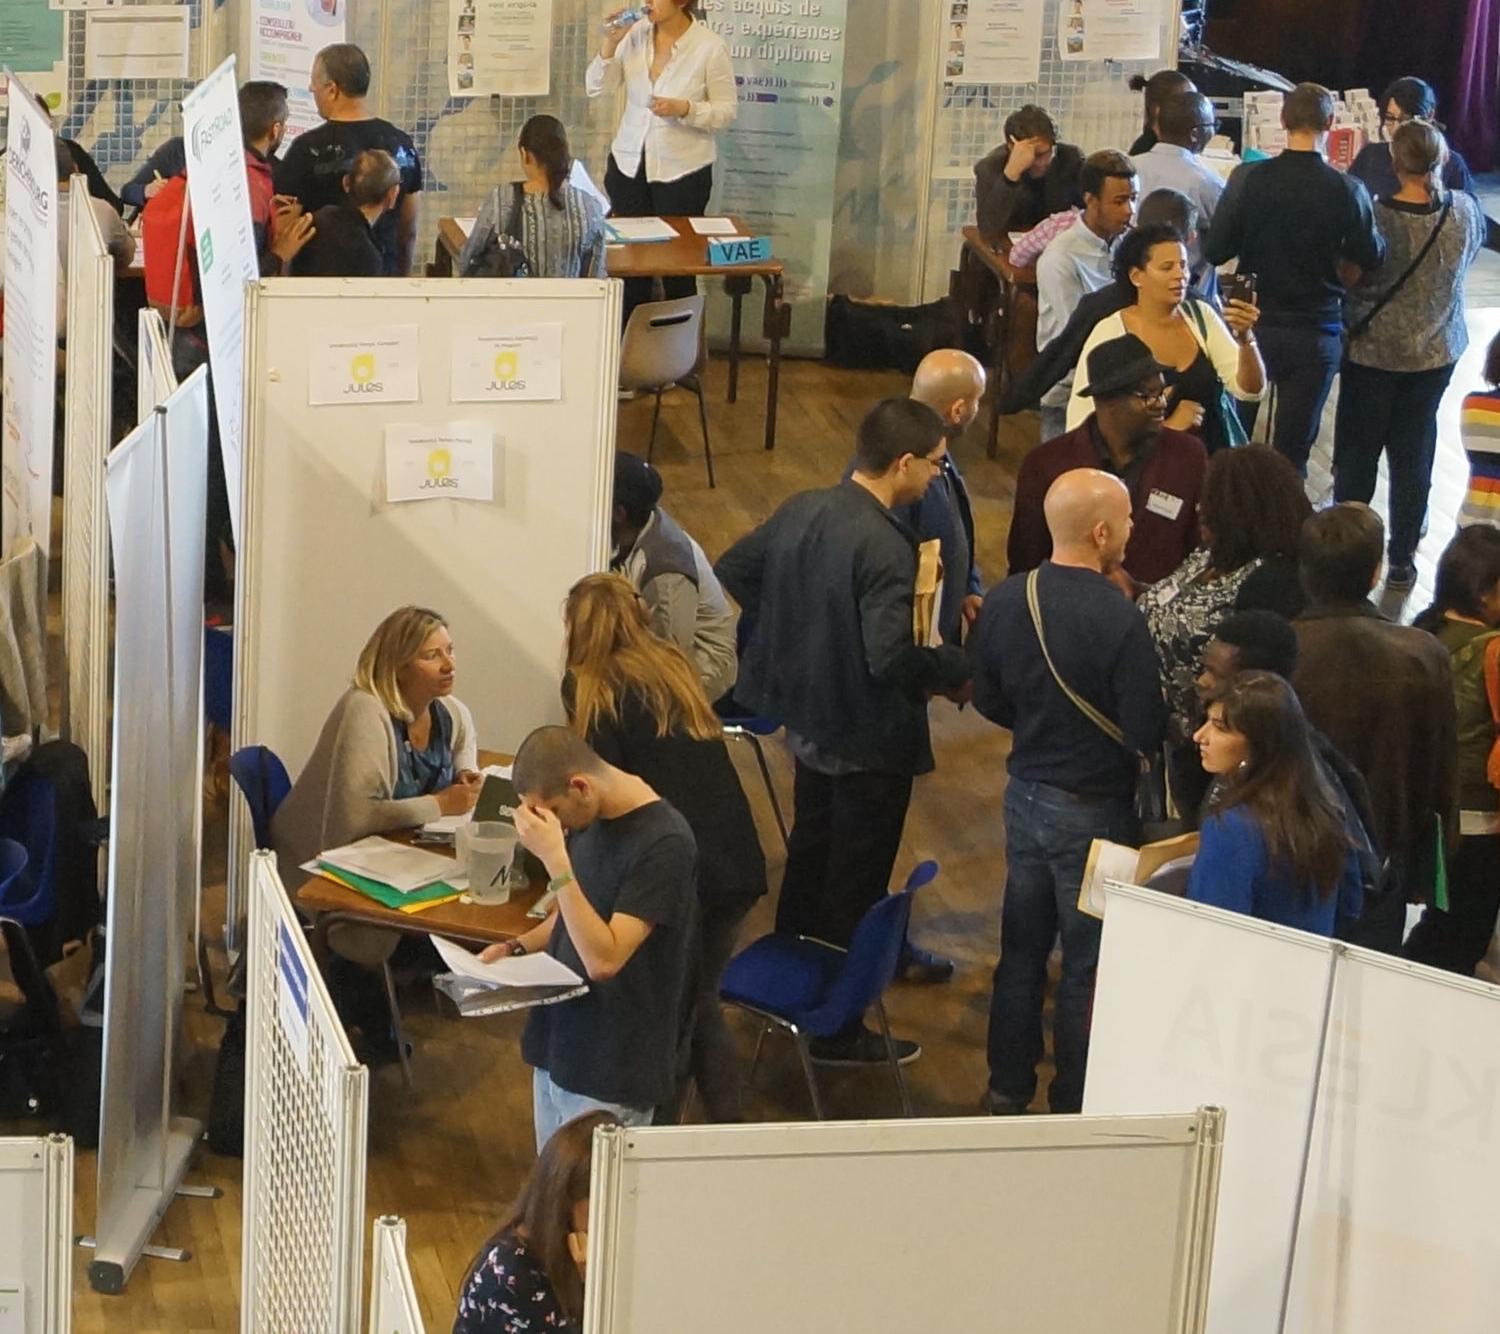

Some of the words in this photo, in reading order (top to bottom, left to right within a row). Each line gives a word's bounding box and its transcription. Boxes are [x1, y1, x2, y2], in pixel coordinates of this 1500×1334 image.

[741, 19, 842, 41] expérience
[757, 44, 831, 64] diplôme
[720, 240, 762, 261] VAE
